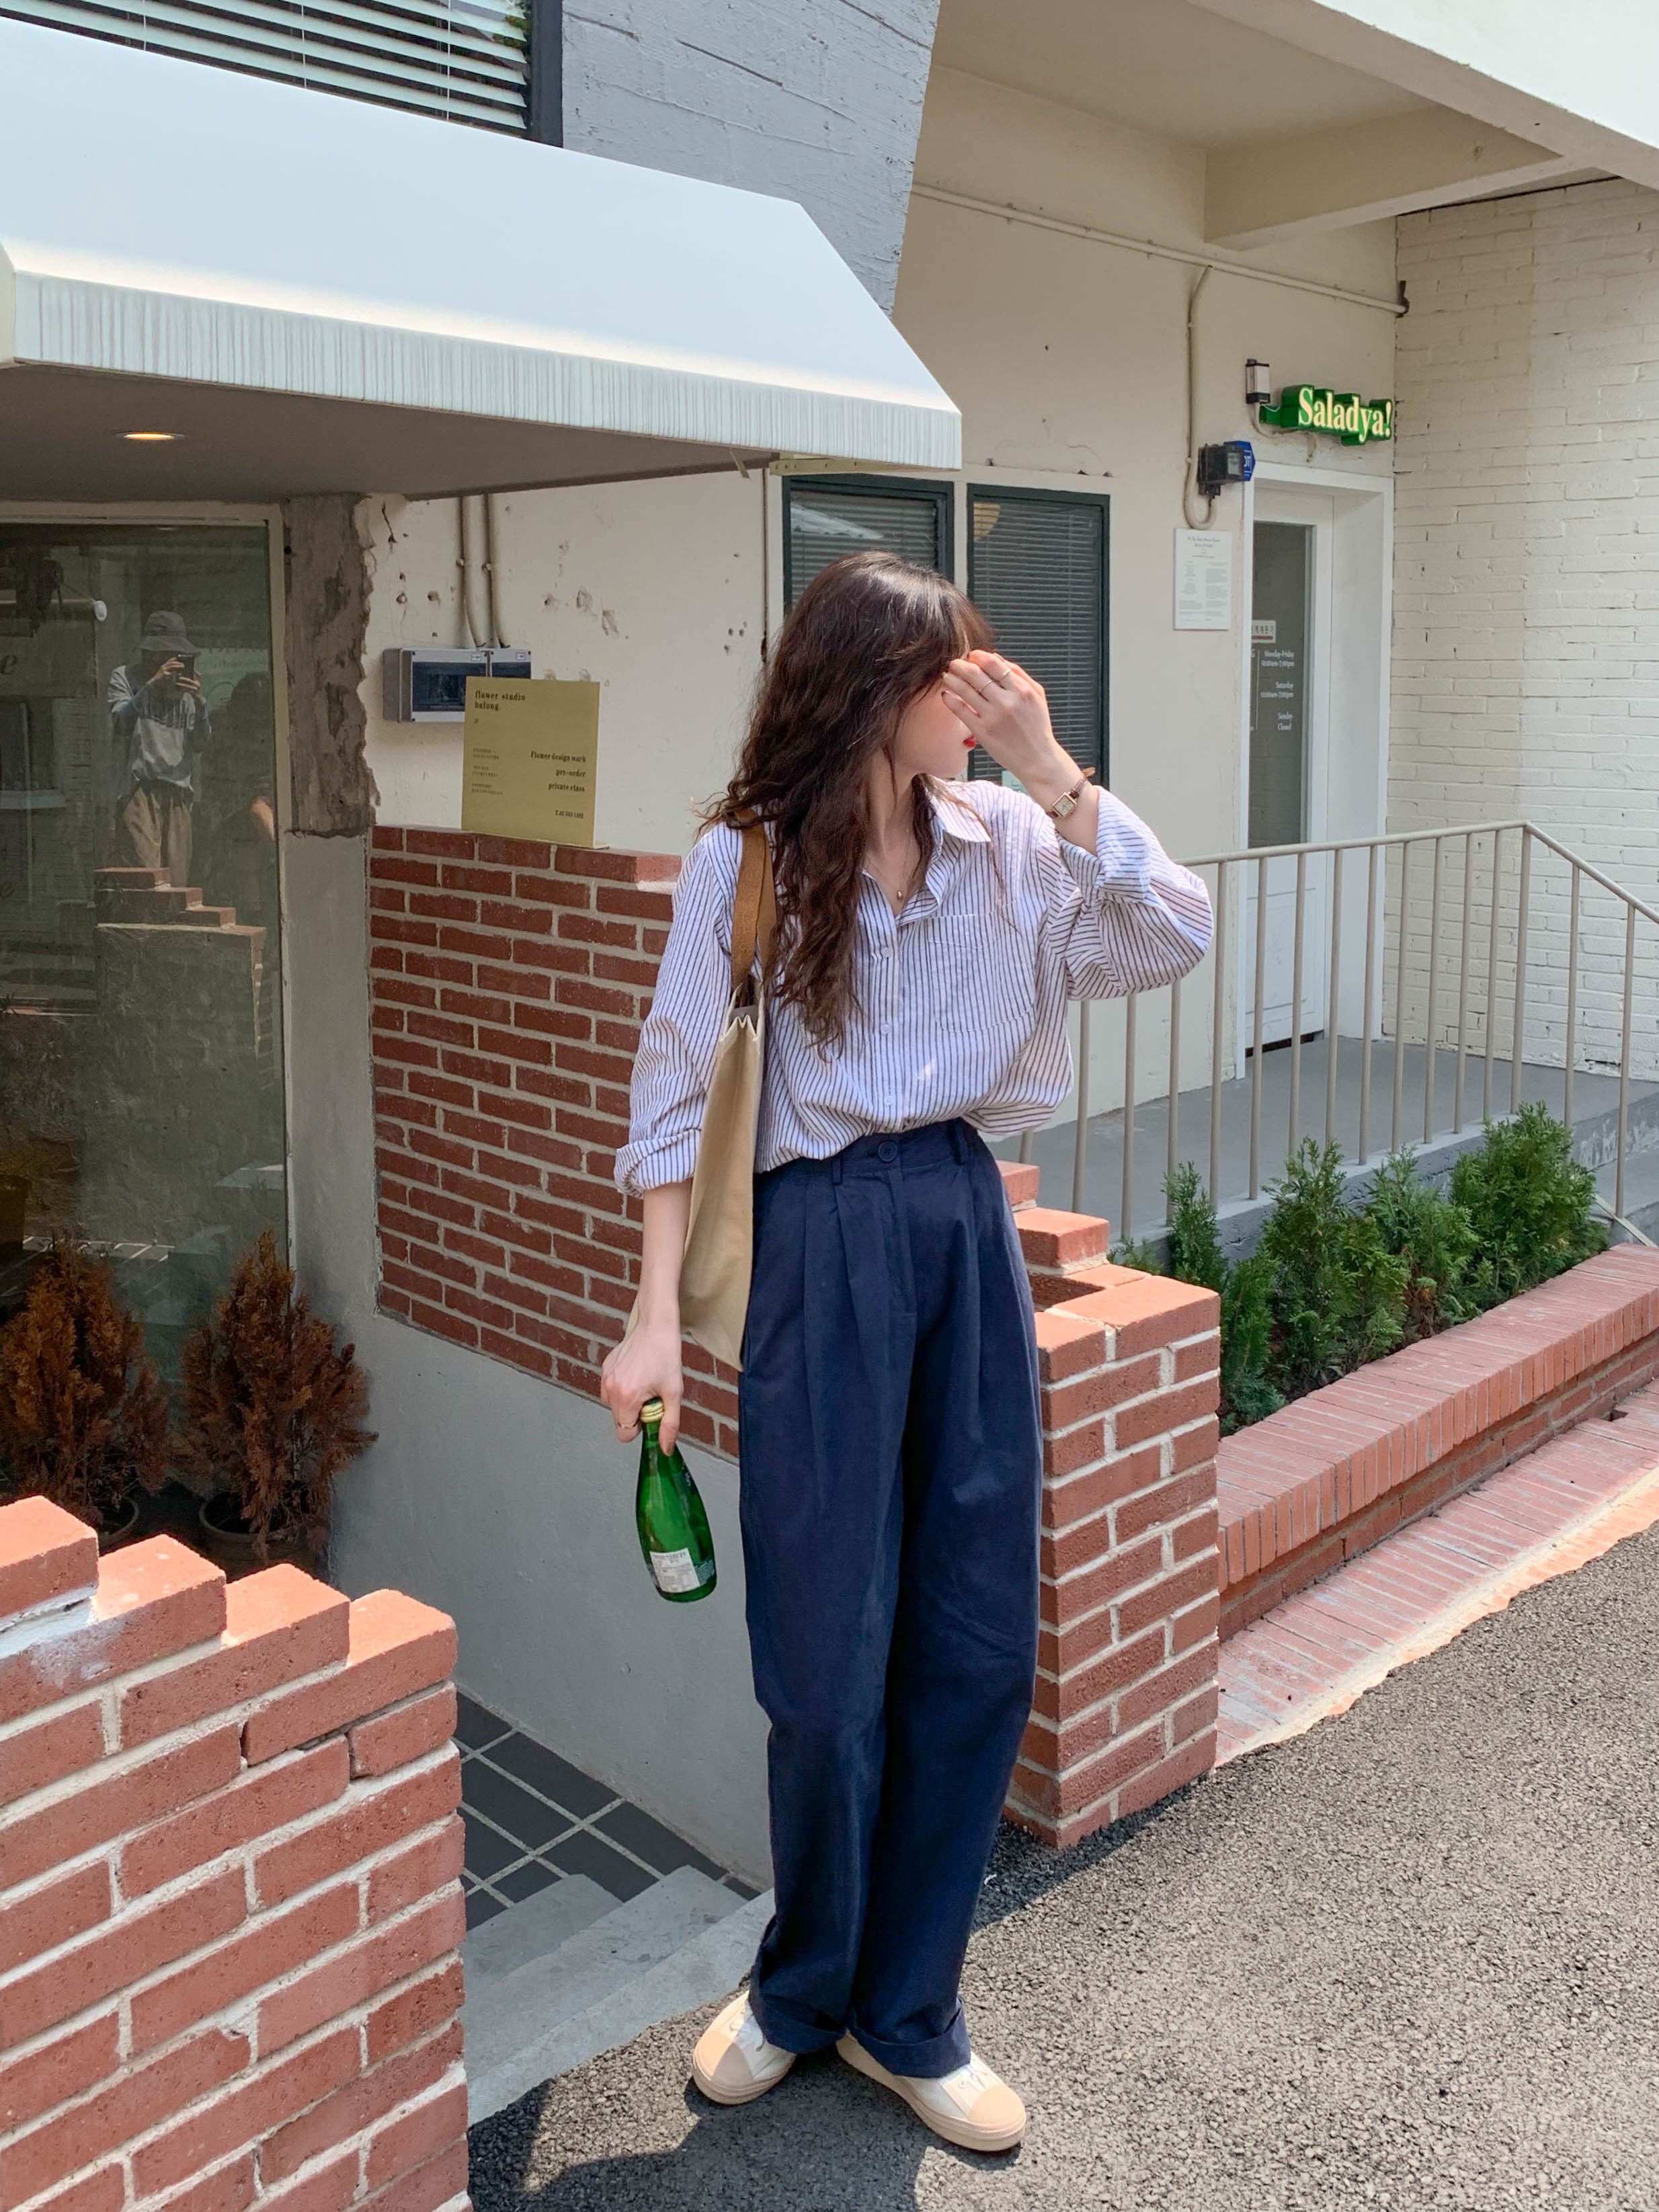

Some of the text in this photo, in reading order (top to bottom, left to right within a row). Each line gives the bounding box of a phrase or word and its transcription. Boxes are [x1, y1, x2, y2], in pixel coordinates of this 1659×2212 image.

[1298, 387, 1391, 442] Saladya!
[475, 690, 526, 701] flower studio
[1277, 723, 1291, 731] Closed
[551, 753, 570, 762] design
[555, 769, 586, 778] pre-order
[548, 782, 569, 791] private
